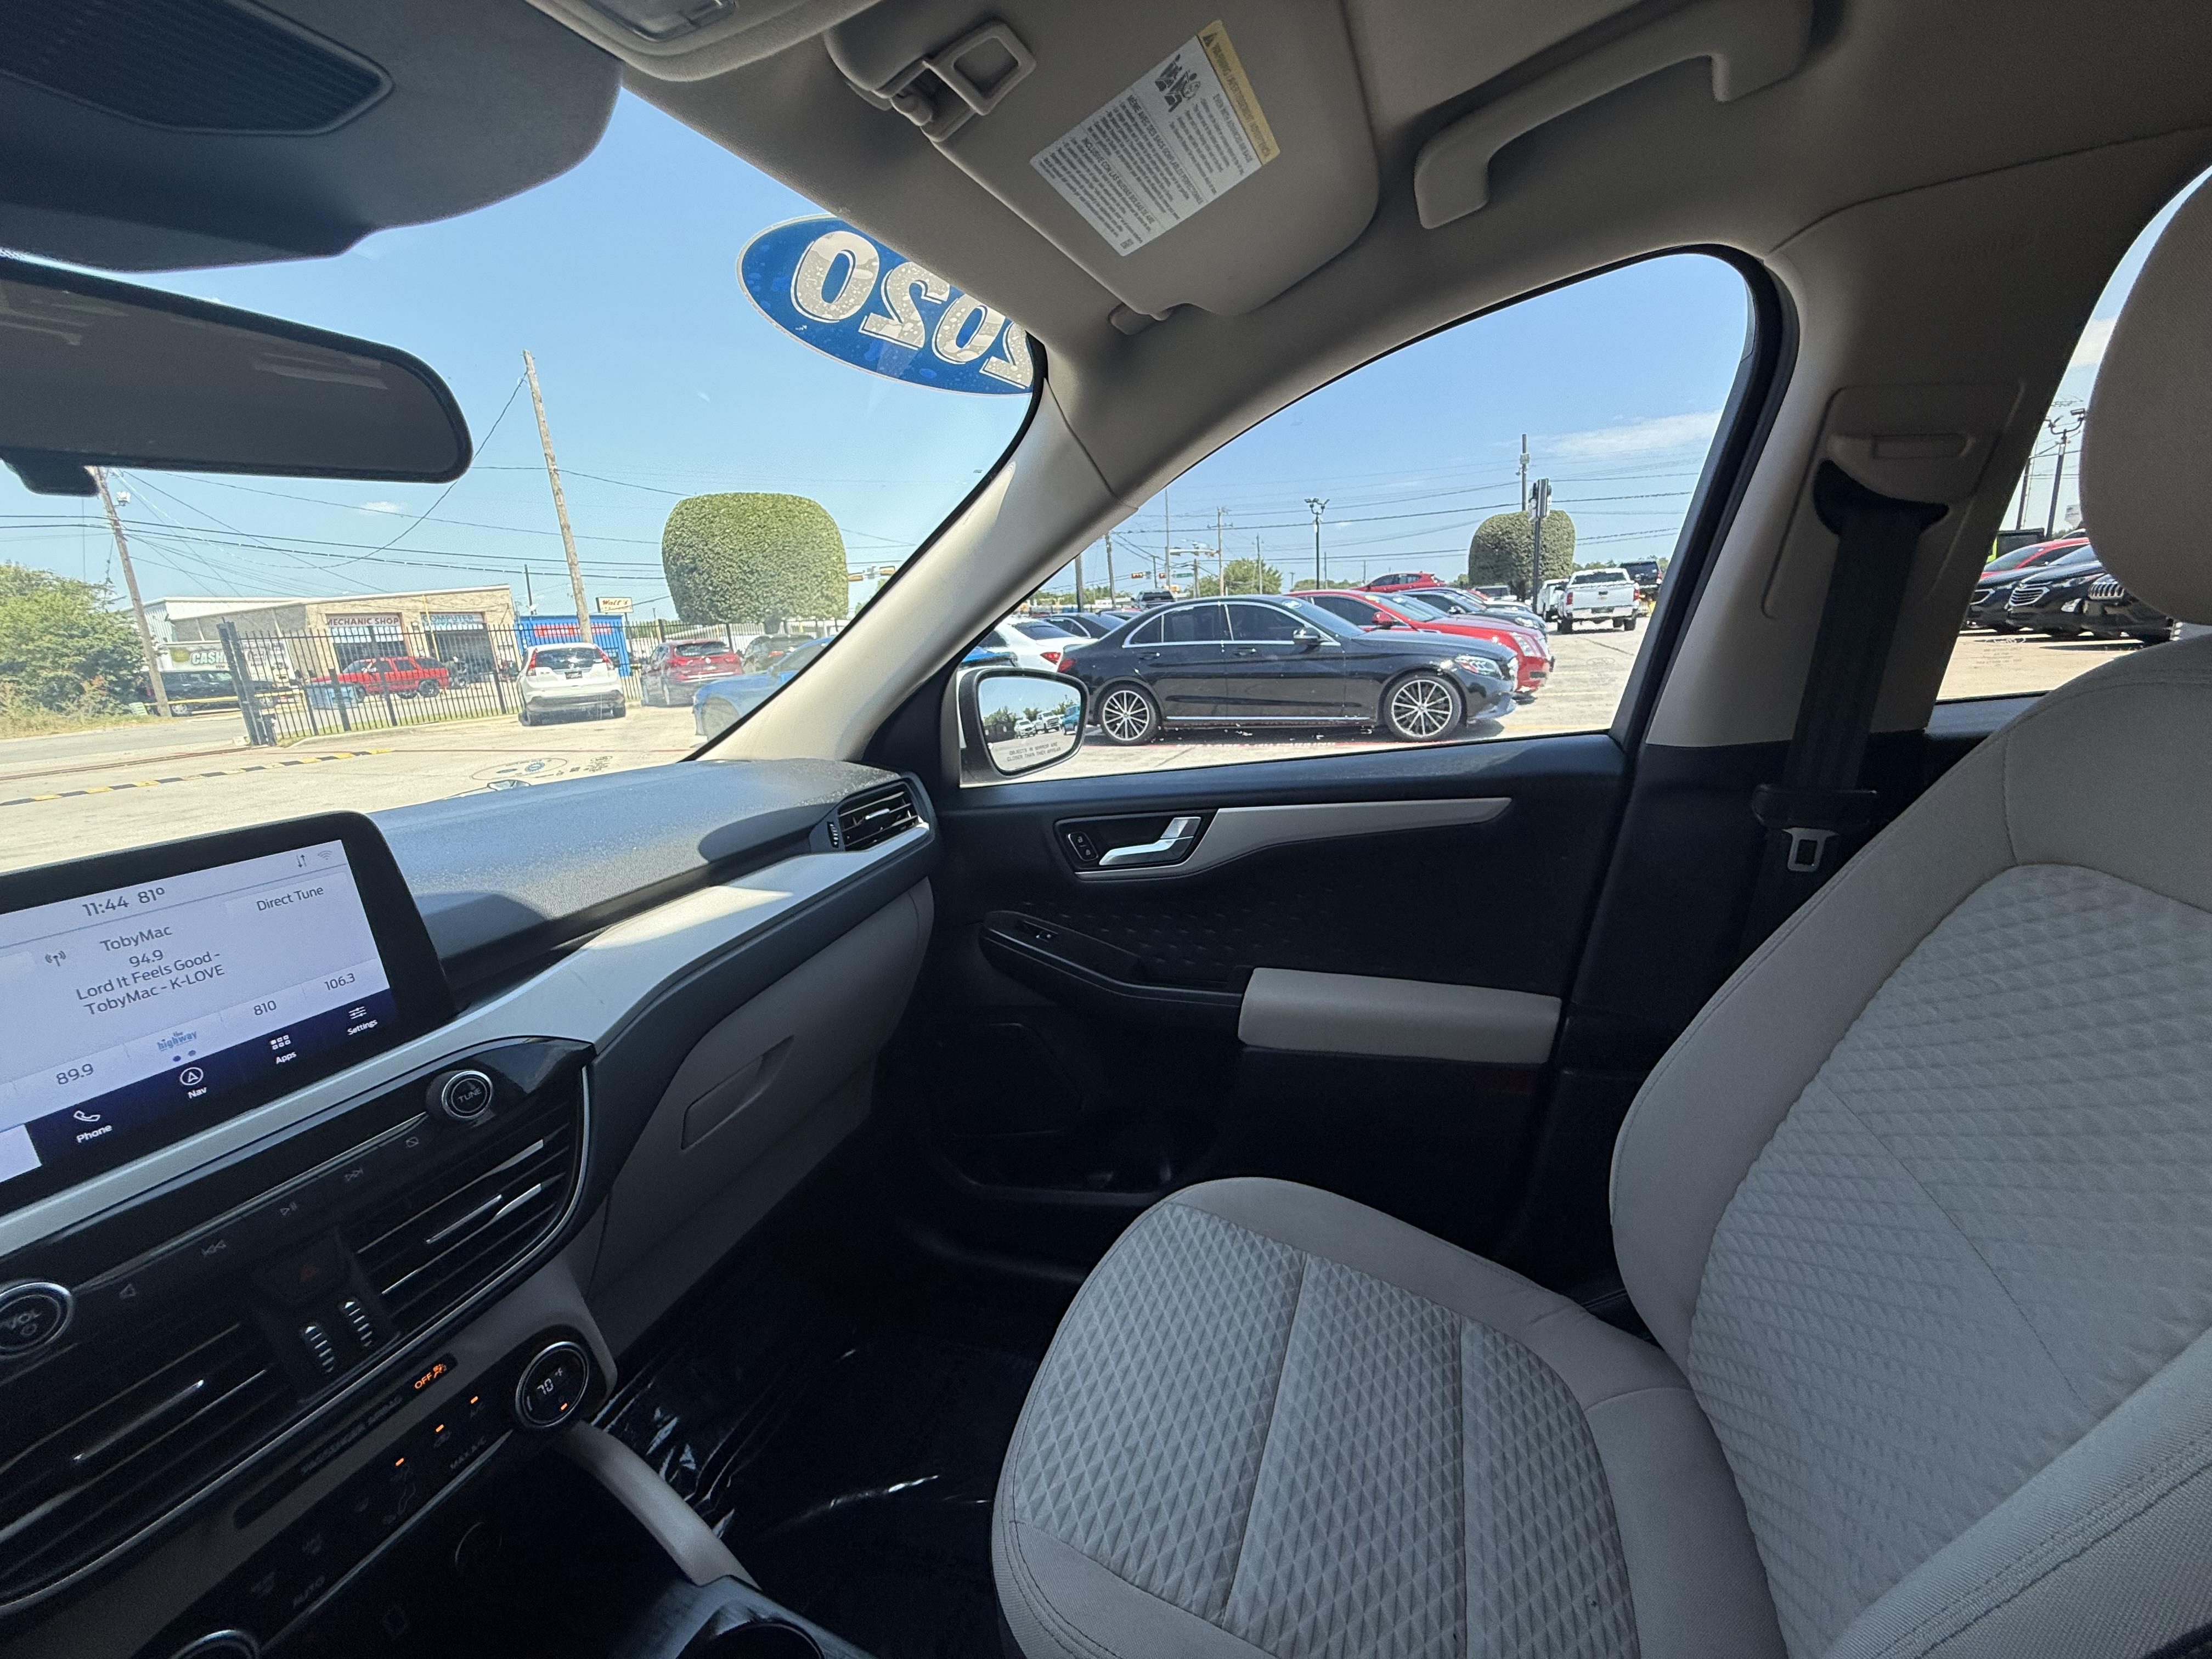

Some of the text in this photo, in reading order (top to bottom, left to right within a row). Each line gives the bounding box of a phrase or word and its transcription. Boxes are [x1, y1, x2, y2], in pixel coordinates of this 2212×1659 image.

[82, 896, 129, 916] 11:44
[256, 887, 324, 911] Direct Tune
[99, 927, 173, 951] TobyMac
[129, 950, 163, 967] 94.9
[76, 980, 114, 1000] Lord
[116, 976, 131, 988] It
[131, 965, 172, 984] Feels
[174, 951, 212, 971] Good
[324, 973, 356, 991] 106.3
[83, 987, 160, 1015] TobyMac
[169, 964, 225, 990] K-LOVE
[253, 1000, 277, 1016] 810
[347, 1019, 378, 1036] Settings
[157, 1031, 197, 1050] highway
[275, 1050, 297, 1065] Apps
[56, 1063, 94, 1085] 89.9
[188, 1087, 207, 1099] Nav
[458, 1087, 482, 1103] TUNE
[76, 1125, 112, 1143] Phone
[413, 1372, 433, 1390] OFF
[537, 1377, 554, 1395] 70
